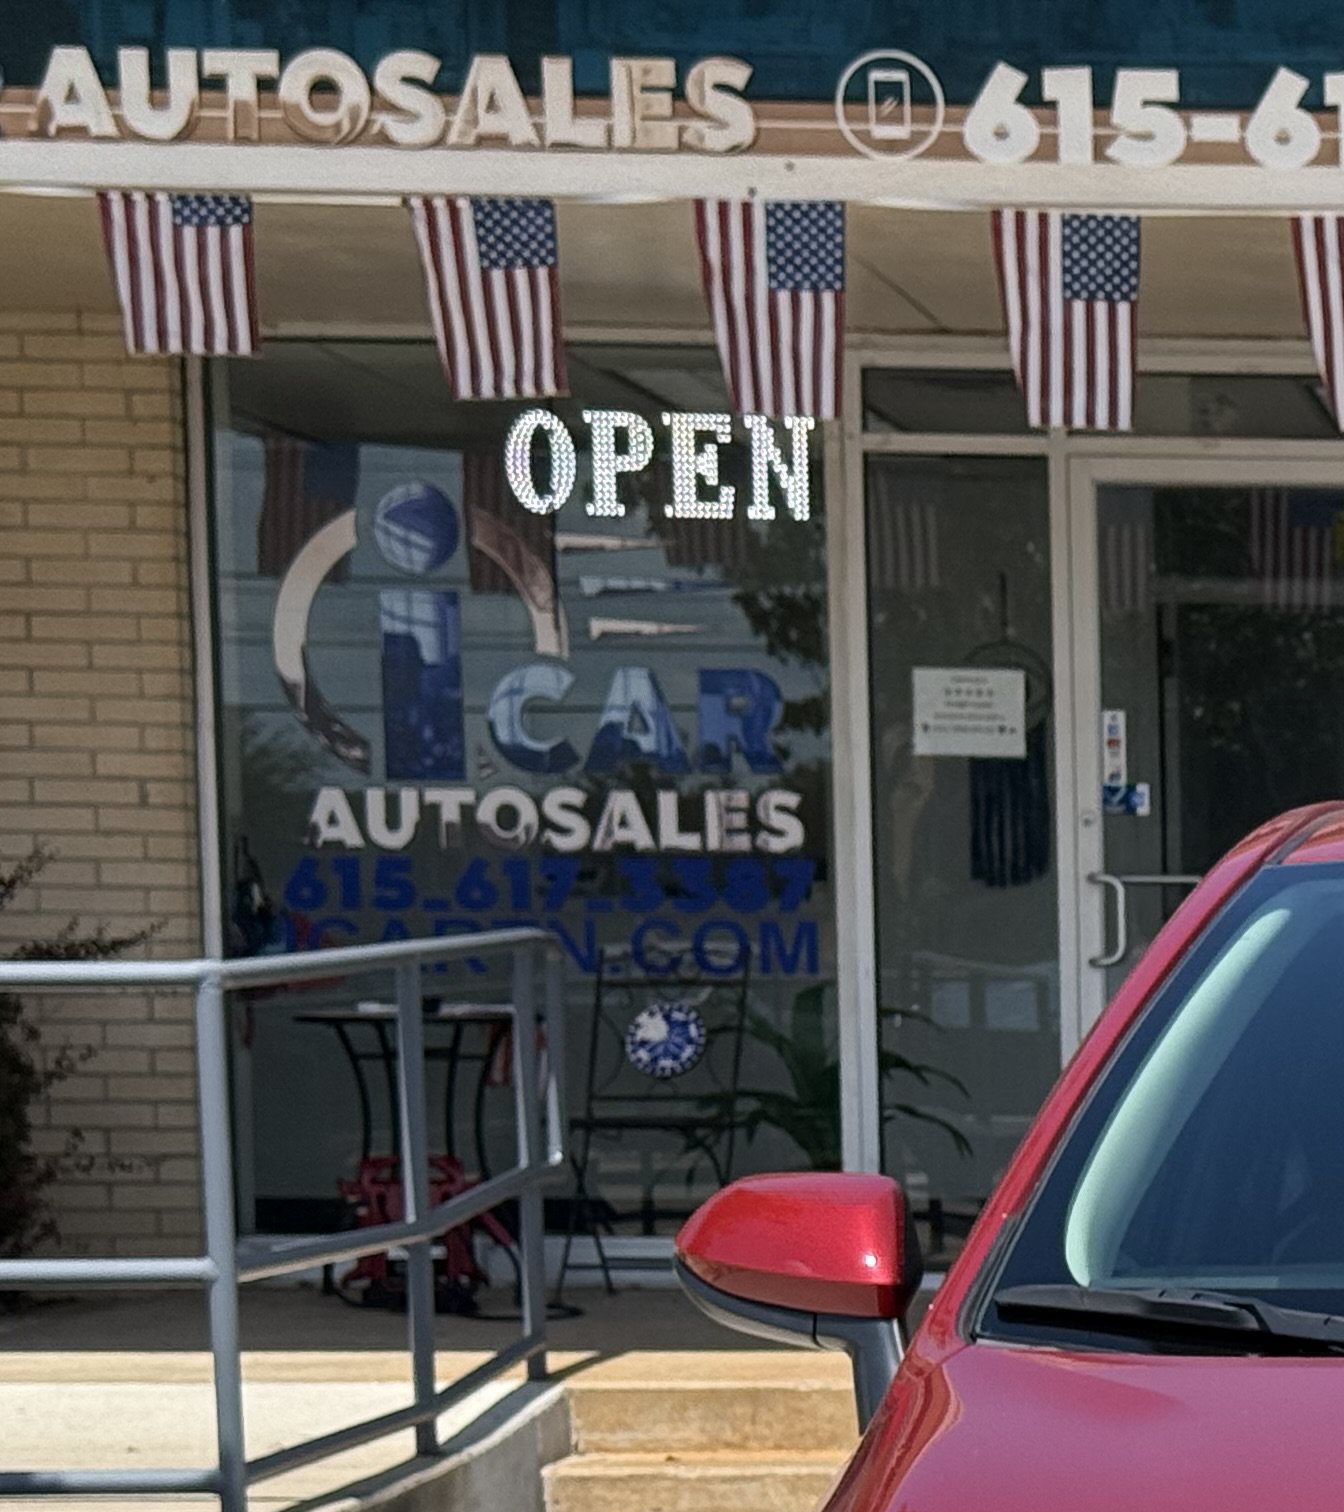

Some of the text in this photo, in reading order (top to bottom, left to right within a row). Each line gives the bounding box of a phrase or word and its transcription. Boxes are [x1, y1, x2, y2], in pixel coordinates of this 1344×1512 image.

[28, 46, 758, 154] AUTOSALES
[504, 408, 816, 521] OPEN
[305, 786, 806, 852] AUTOSALES
